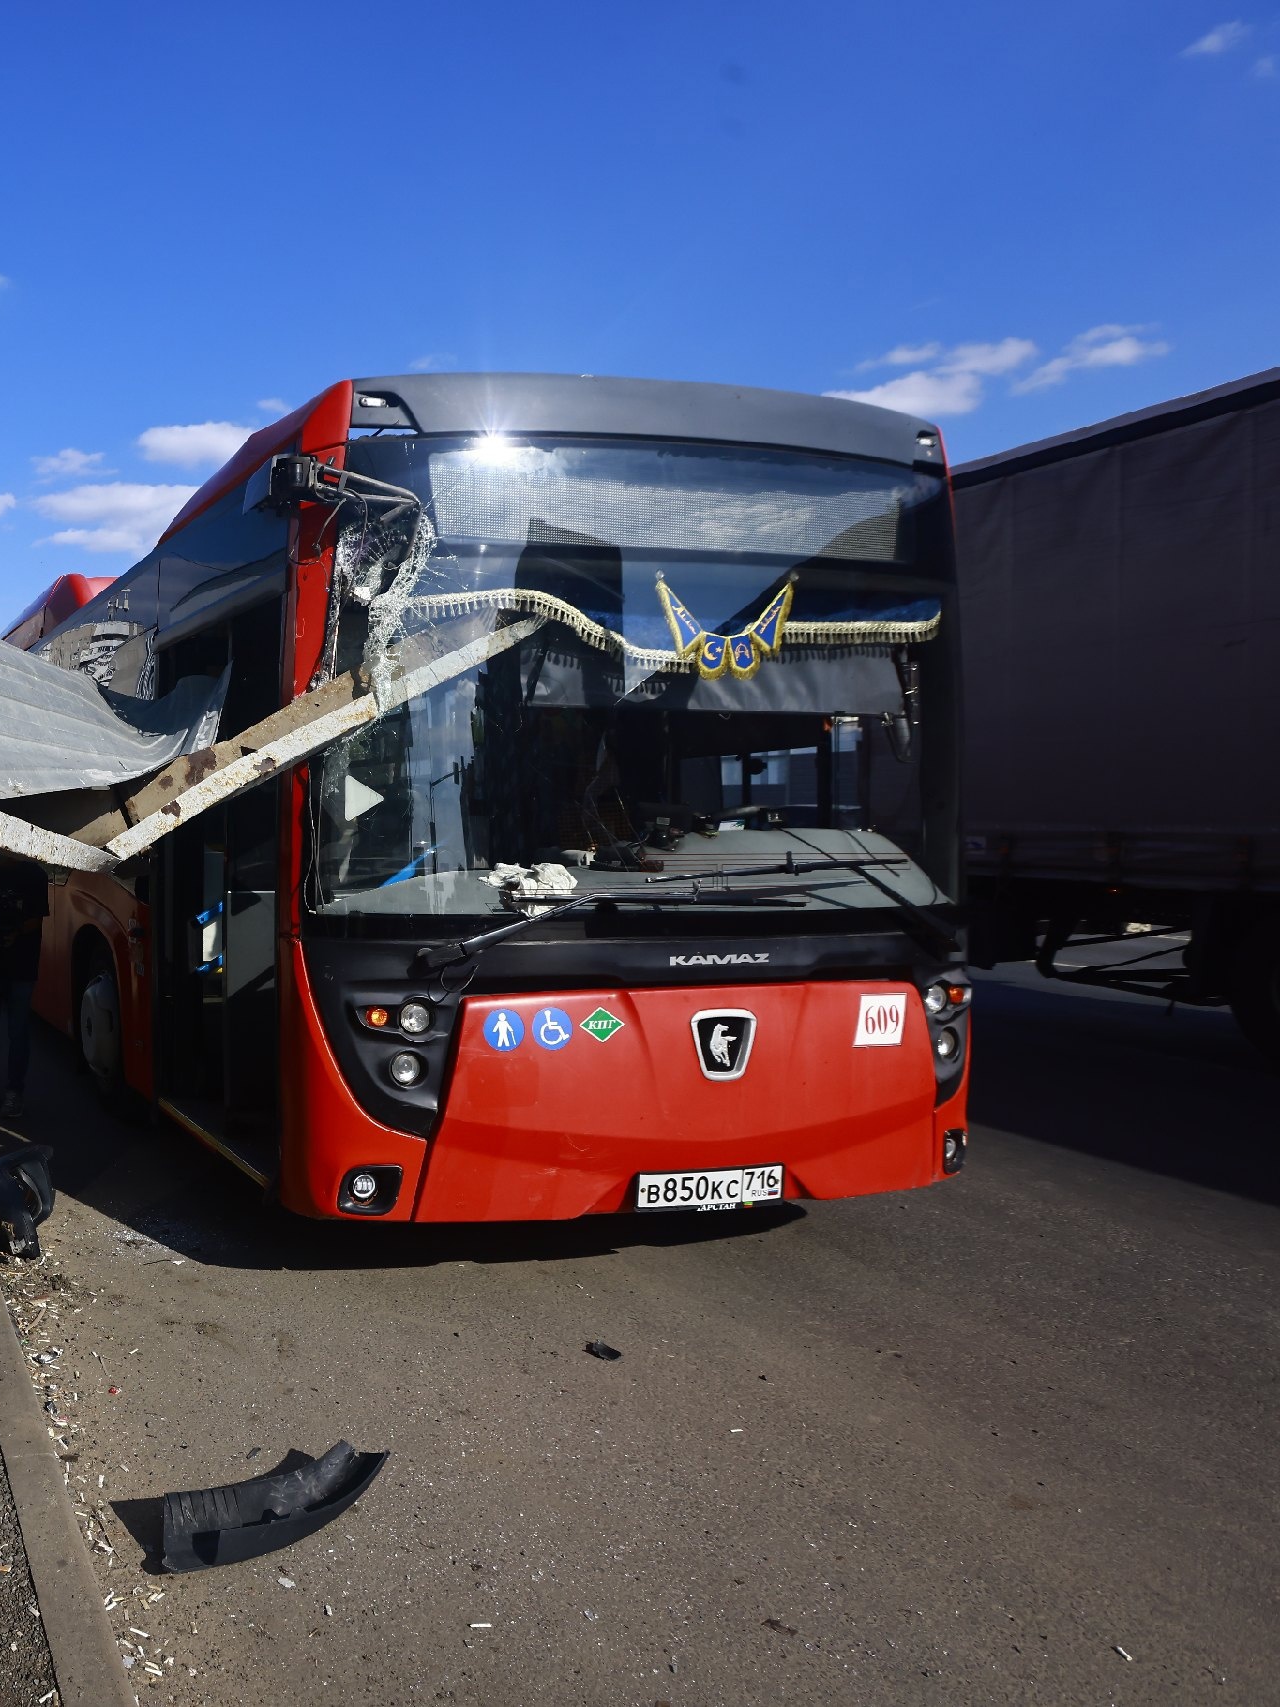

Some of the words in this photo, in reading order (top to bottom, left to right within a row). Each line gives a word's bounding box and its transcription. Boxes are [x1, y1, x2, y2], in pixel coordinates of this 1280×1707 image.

[669, 953, 770, 966] KAMAZ
[587, 1019, 617, 1030] КПГ
[865, 1004, 899, 1034] 609
[745, 1168, 778, 1191] 716
[751, 1189, 768, 1197] RUS
[697, 1202, 737, 1211] АРСТАН
